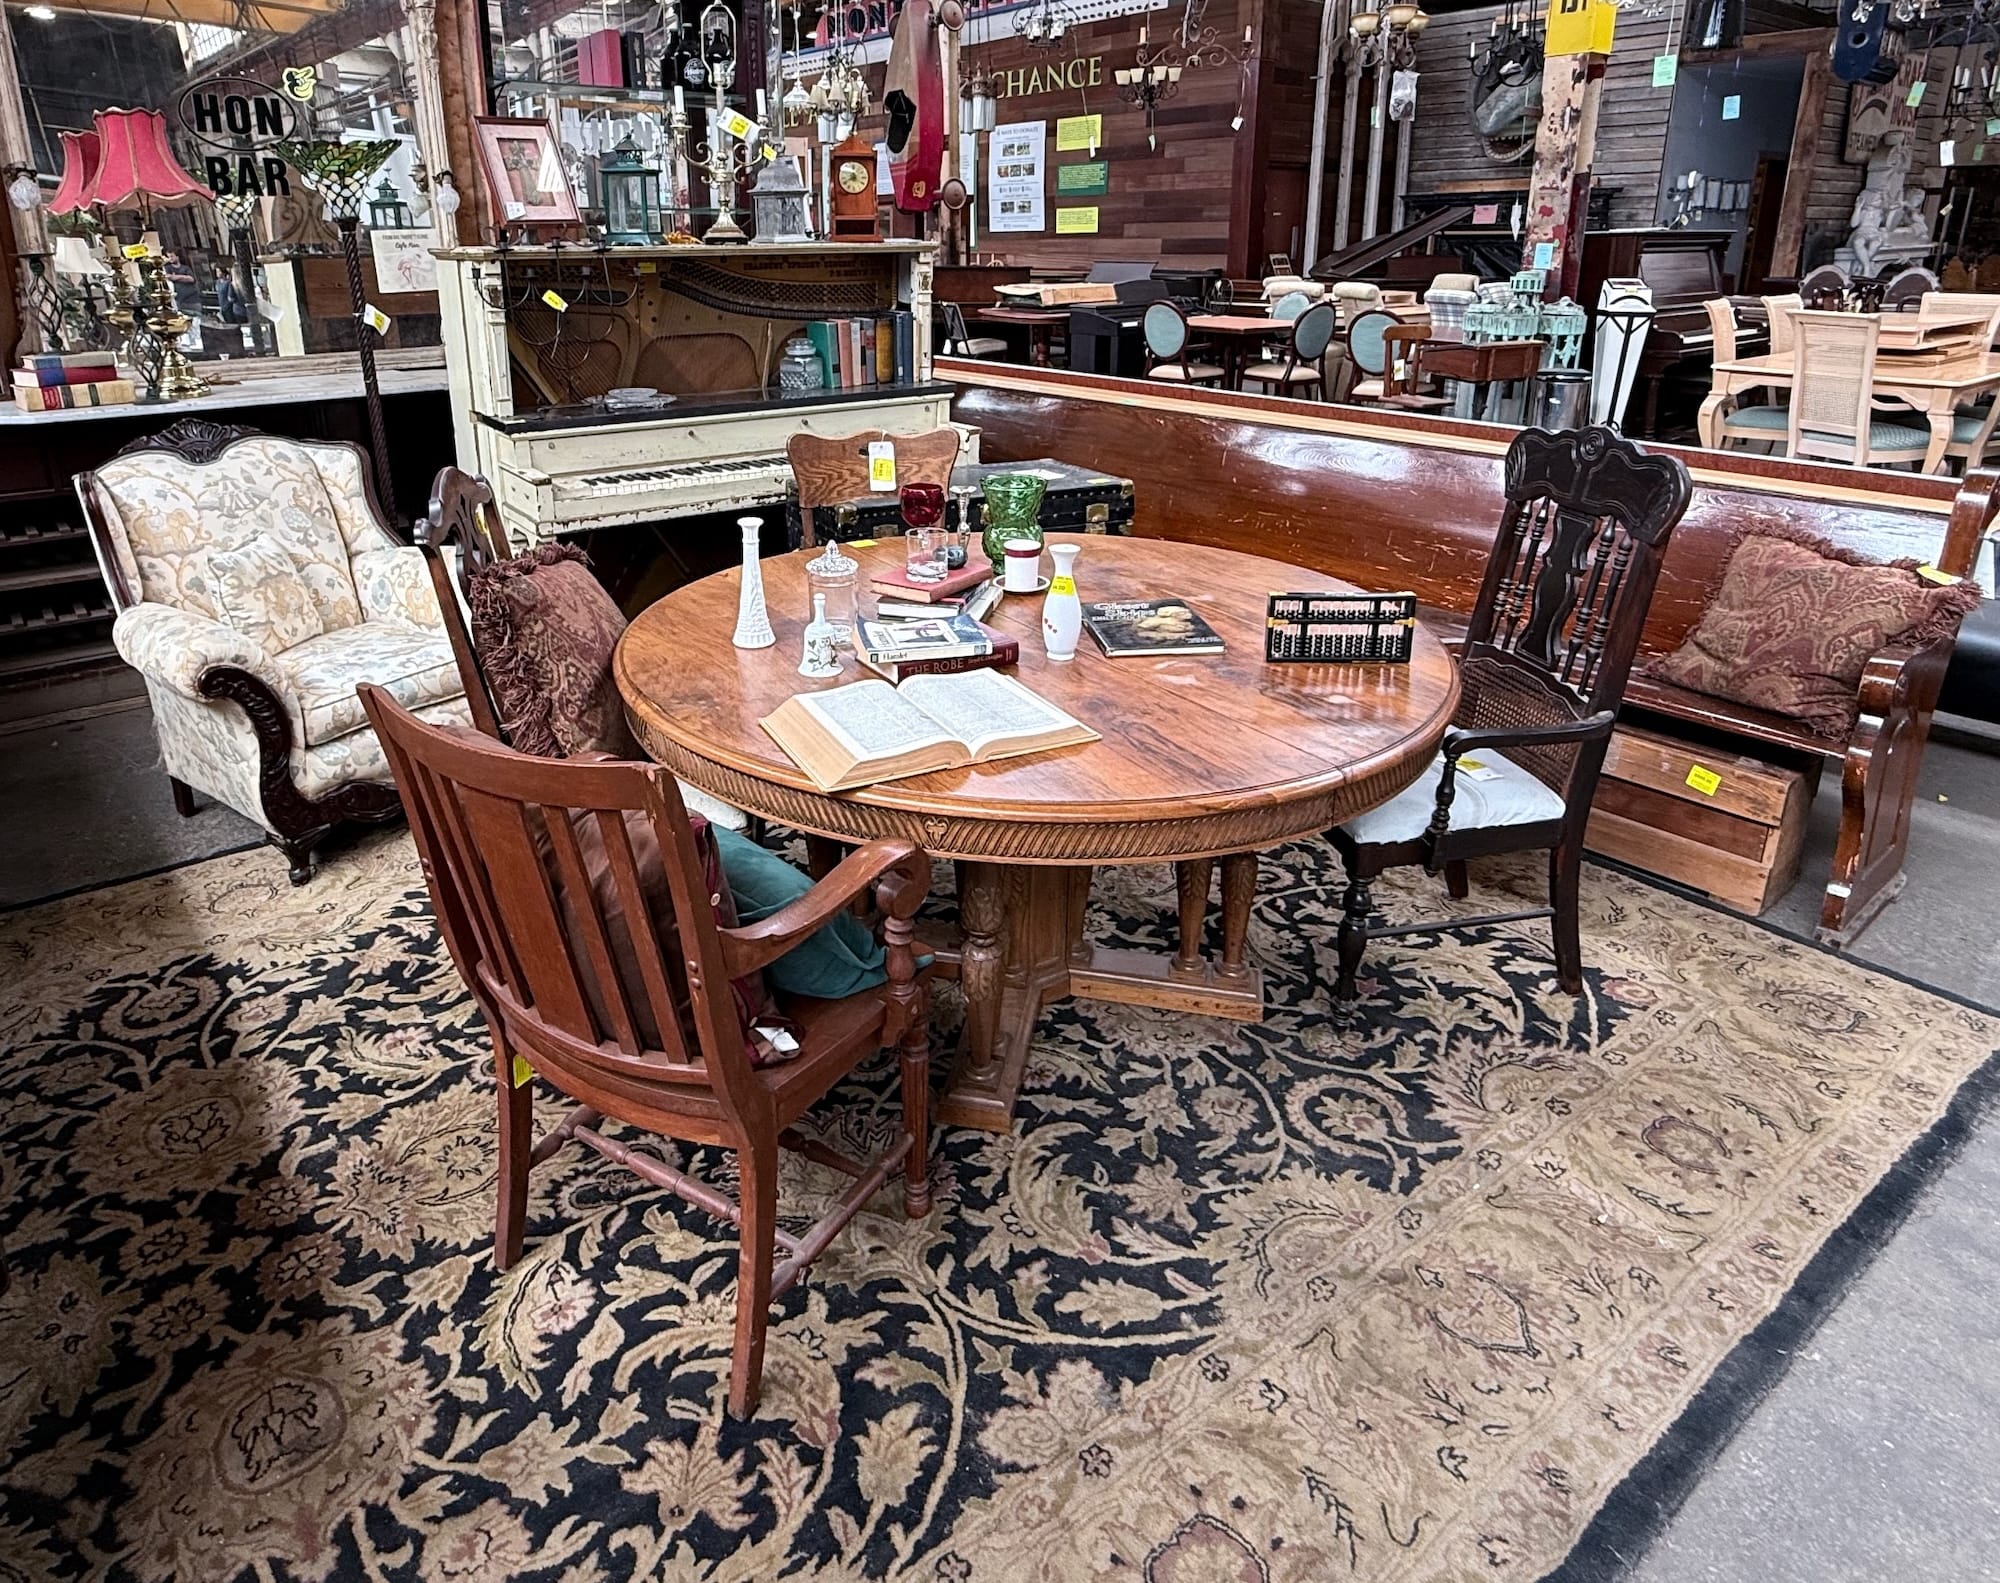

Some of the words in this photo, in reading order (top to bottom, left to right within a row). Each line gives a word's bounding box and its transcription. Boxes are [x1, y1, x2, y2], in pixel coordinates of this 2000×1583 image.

[991, 55, 1103, 99] CHANCE
[191, 93, 285, 136] HON
[205, 155, 292, 197] BAR
[905, 664, 930, 675] THE
[933, 658, 965, 673] ROBE
